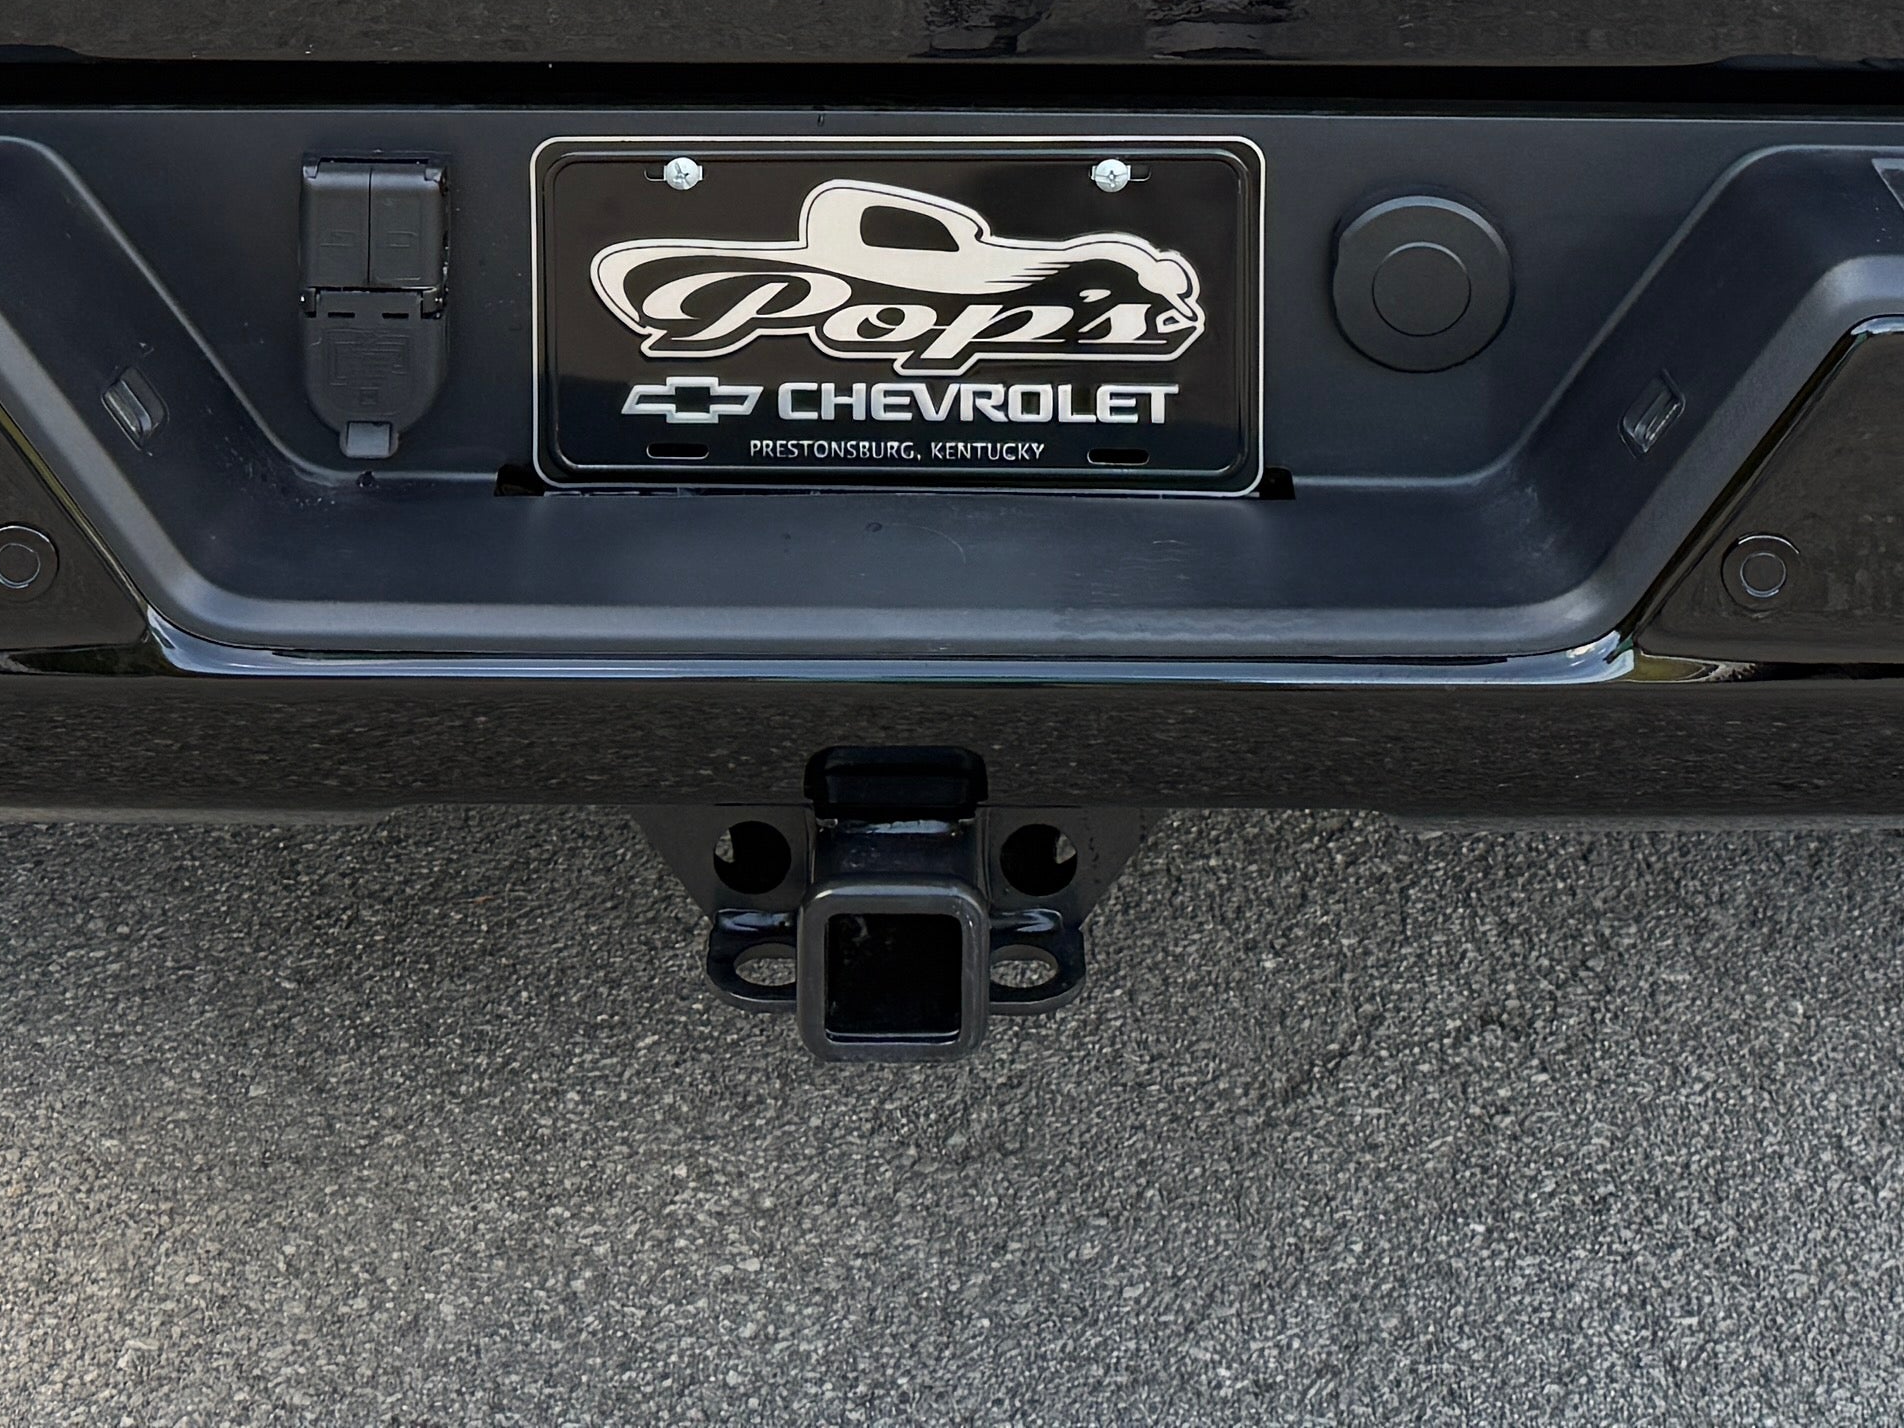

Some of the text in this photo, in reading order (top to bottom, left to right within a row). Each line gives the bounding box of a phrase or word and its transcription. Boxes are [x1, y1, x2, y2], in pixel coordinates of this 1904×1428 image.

[641, 271, 1168, 360] Pop's
[777, 382, 1180, 424] CHEVROLET
[749, 439, 1046, 462] PRESTONSBURG, KENTUCKY
